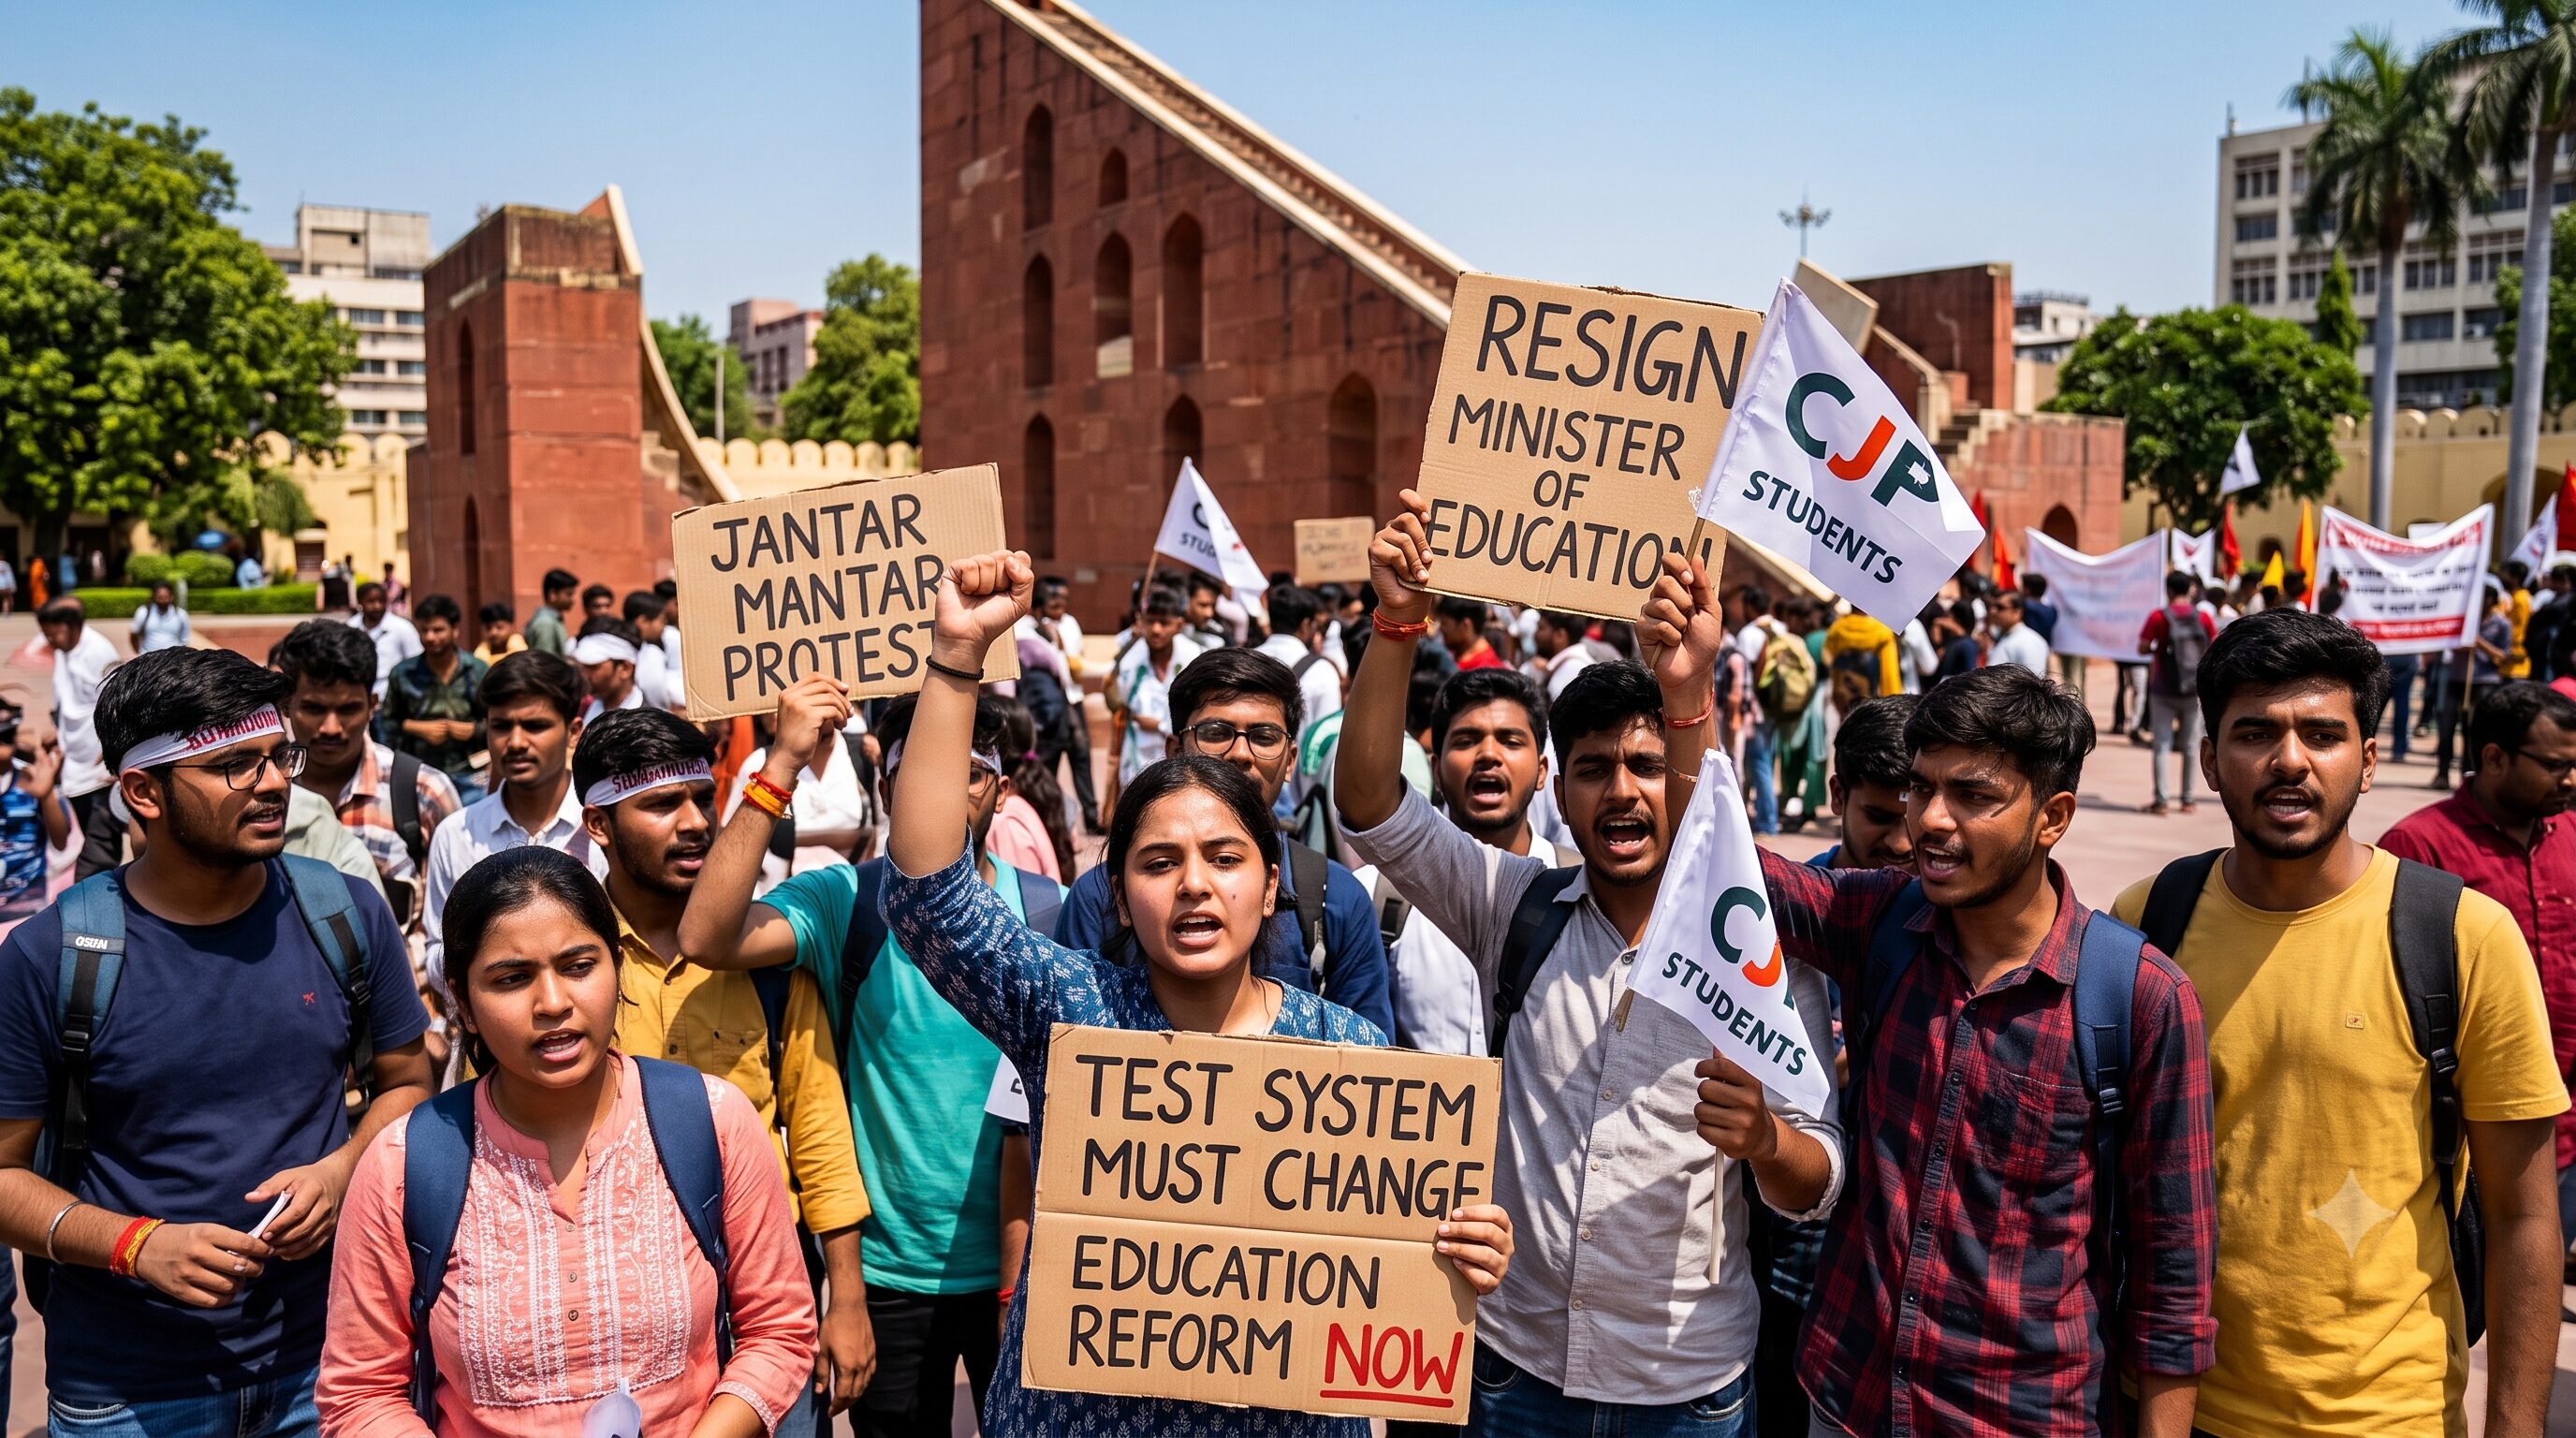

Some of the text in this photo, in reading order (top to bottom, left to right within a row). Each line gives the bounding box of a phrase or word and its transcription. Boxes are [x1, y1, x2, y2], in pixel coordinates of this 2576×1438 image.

[1476, 295, 1748, 410] RESIGN
[1449, 394, 1685, 480] MINISTER
[1785, 372, 1940, 507] CJP
[710, 493, 927, 572] JANTAR
[1533, 470, 1590, 511] OF
[1742, 470, 1903, 584] STUDENTS
[734, 554, 944, 634] MANTAR
[1710, 886, 1795, 1011] CJ
[1661, 951, 1807, 1076] STUDENTS
[1076, 1054, 1476, 1146] TEST SYSTEM
[1082, 1138, 1485, 1221] MUST CHANGE
[1072, 1235, 1381, 1310] EDUCATION
[1068, 1304, 1465, 1394] REFORM NOW
